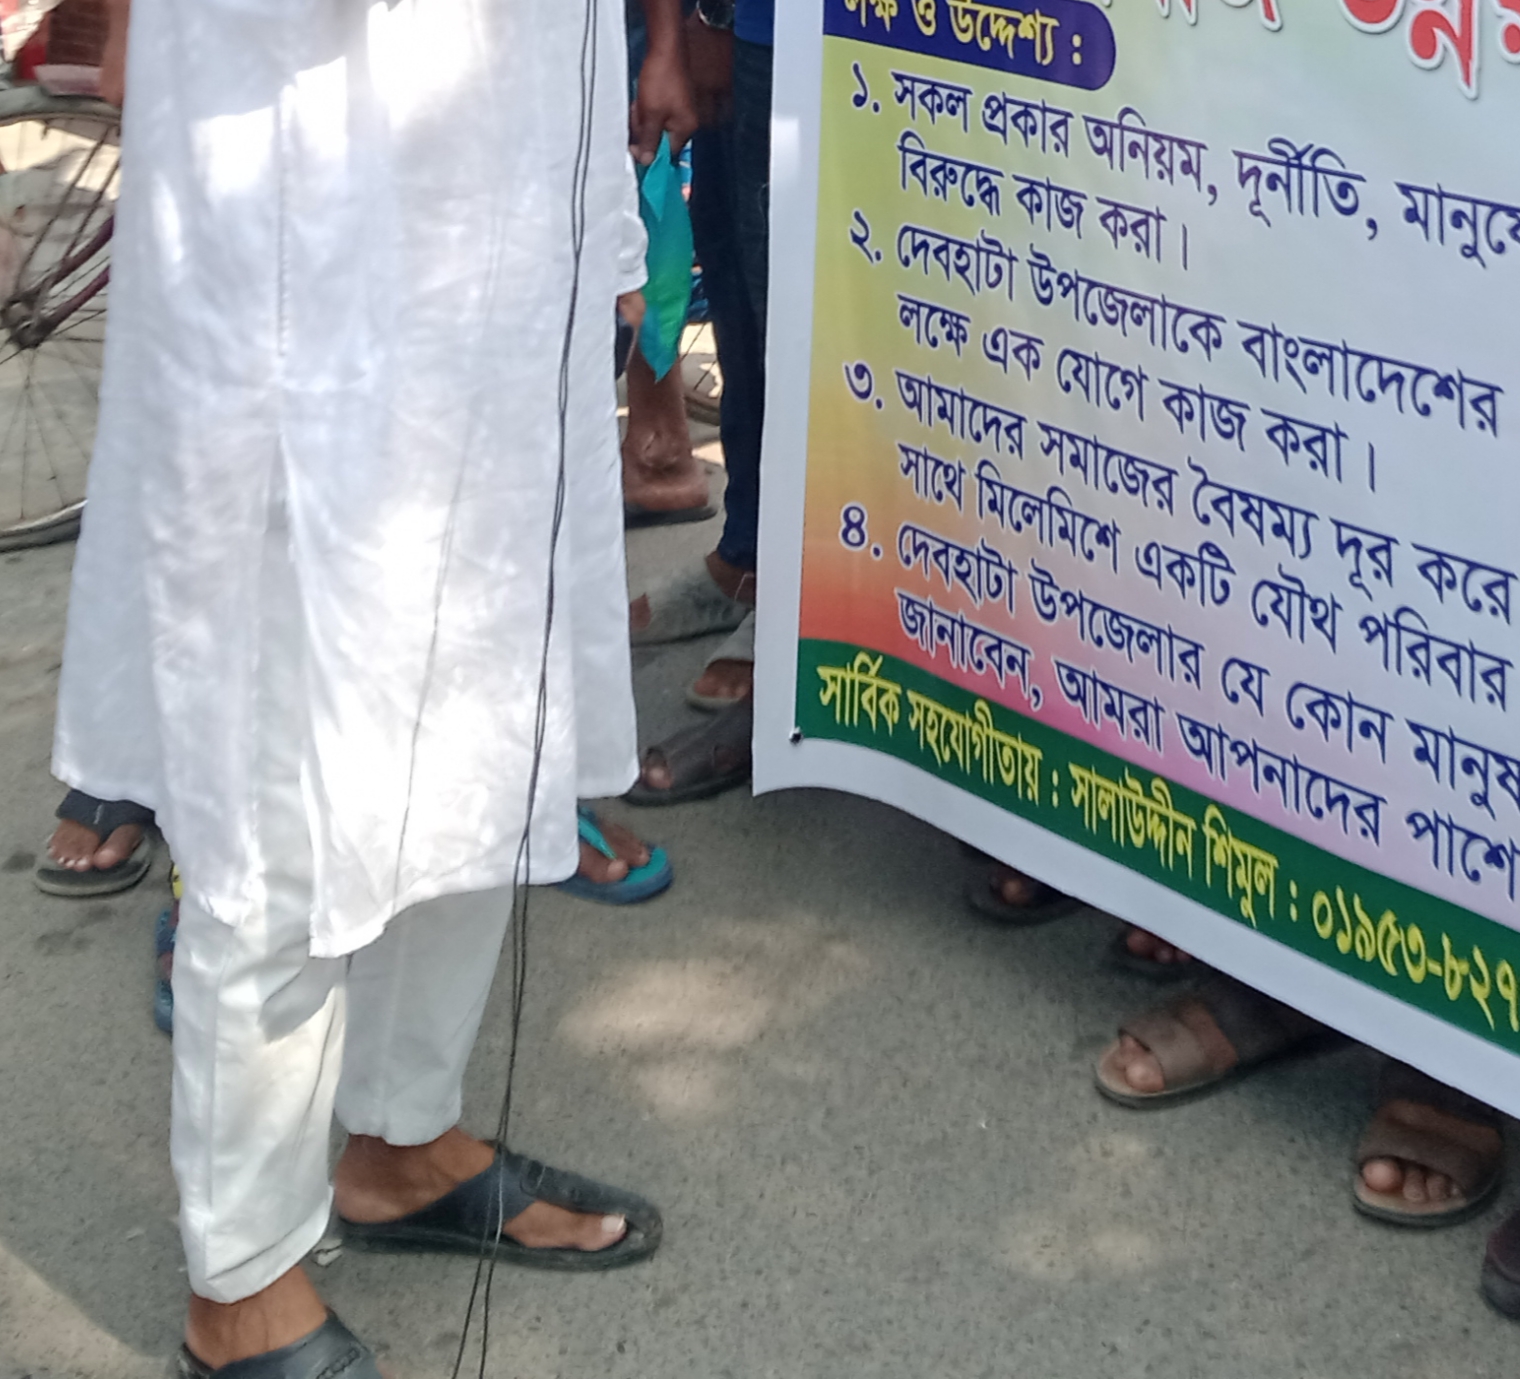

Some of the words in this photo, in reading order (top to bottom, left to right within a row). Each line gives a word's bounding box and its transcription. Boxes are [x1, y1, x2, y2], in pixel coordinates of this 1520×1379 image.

[892, 72, 972, 136] সকল
[982, 90, 1073, 160] প্রকার
[1083, 108, 1219, 207] অনিয়ম,
[897, 130, 1003, 217] বিরুদ্ধে
[1012, 173, 1088, 240] কাজ
[1097, 196, 1172, 265] করা
[896, 224, 1018, 302] দেবহাটা
[1027, 243, 1227, 361] উপজেলাকে
[1236, 319, 1504, 437] বাংলাদেশের
[896, 293, 971, 356] লক্ষে
[982, 325, 1045, 381] এক
[1056, 347, 1150, 421] যোগে
[1158, 377, 1251, 452] কাজ
[1260, 407, 1349, 484] করা
[896, 369, 1027, 460] আমাদের
[1037, 419, 1180, 516] সমাজের
[1187, 456, 1319, 560] বৈষম্য
[1329, 517, 1399, 601] দূর
[1410, 542, 1518, 625] করে
[898, 442, 966, 513] সাথে
[976, 458, 1121, 574] মিলেমিশে
[1134, 540, 1237, 608] একটি
[1250, 563, 1343, 654] যৌথ
[1359, 606, 1515, 713] পরিবার
[894, 587, 1044, 712] জানাবেন,
[1052, 654, 1166, 756] আমরা
[1175, 709, 1388, 847] আপনাদের
[896, 521, 1018, 615] দেবহাটা
[1027, 557, 1206, 690] উপজেলার
[1220, 656, 1271, 718] যে
[1286, 680, 1394, 764] কোন
[816, 651, 903, 738] সার্বিক
[1067, 760, 1198, 881] সালাউদ্দীন
[1201, 803, 1279, 929] শিমুল
